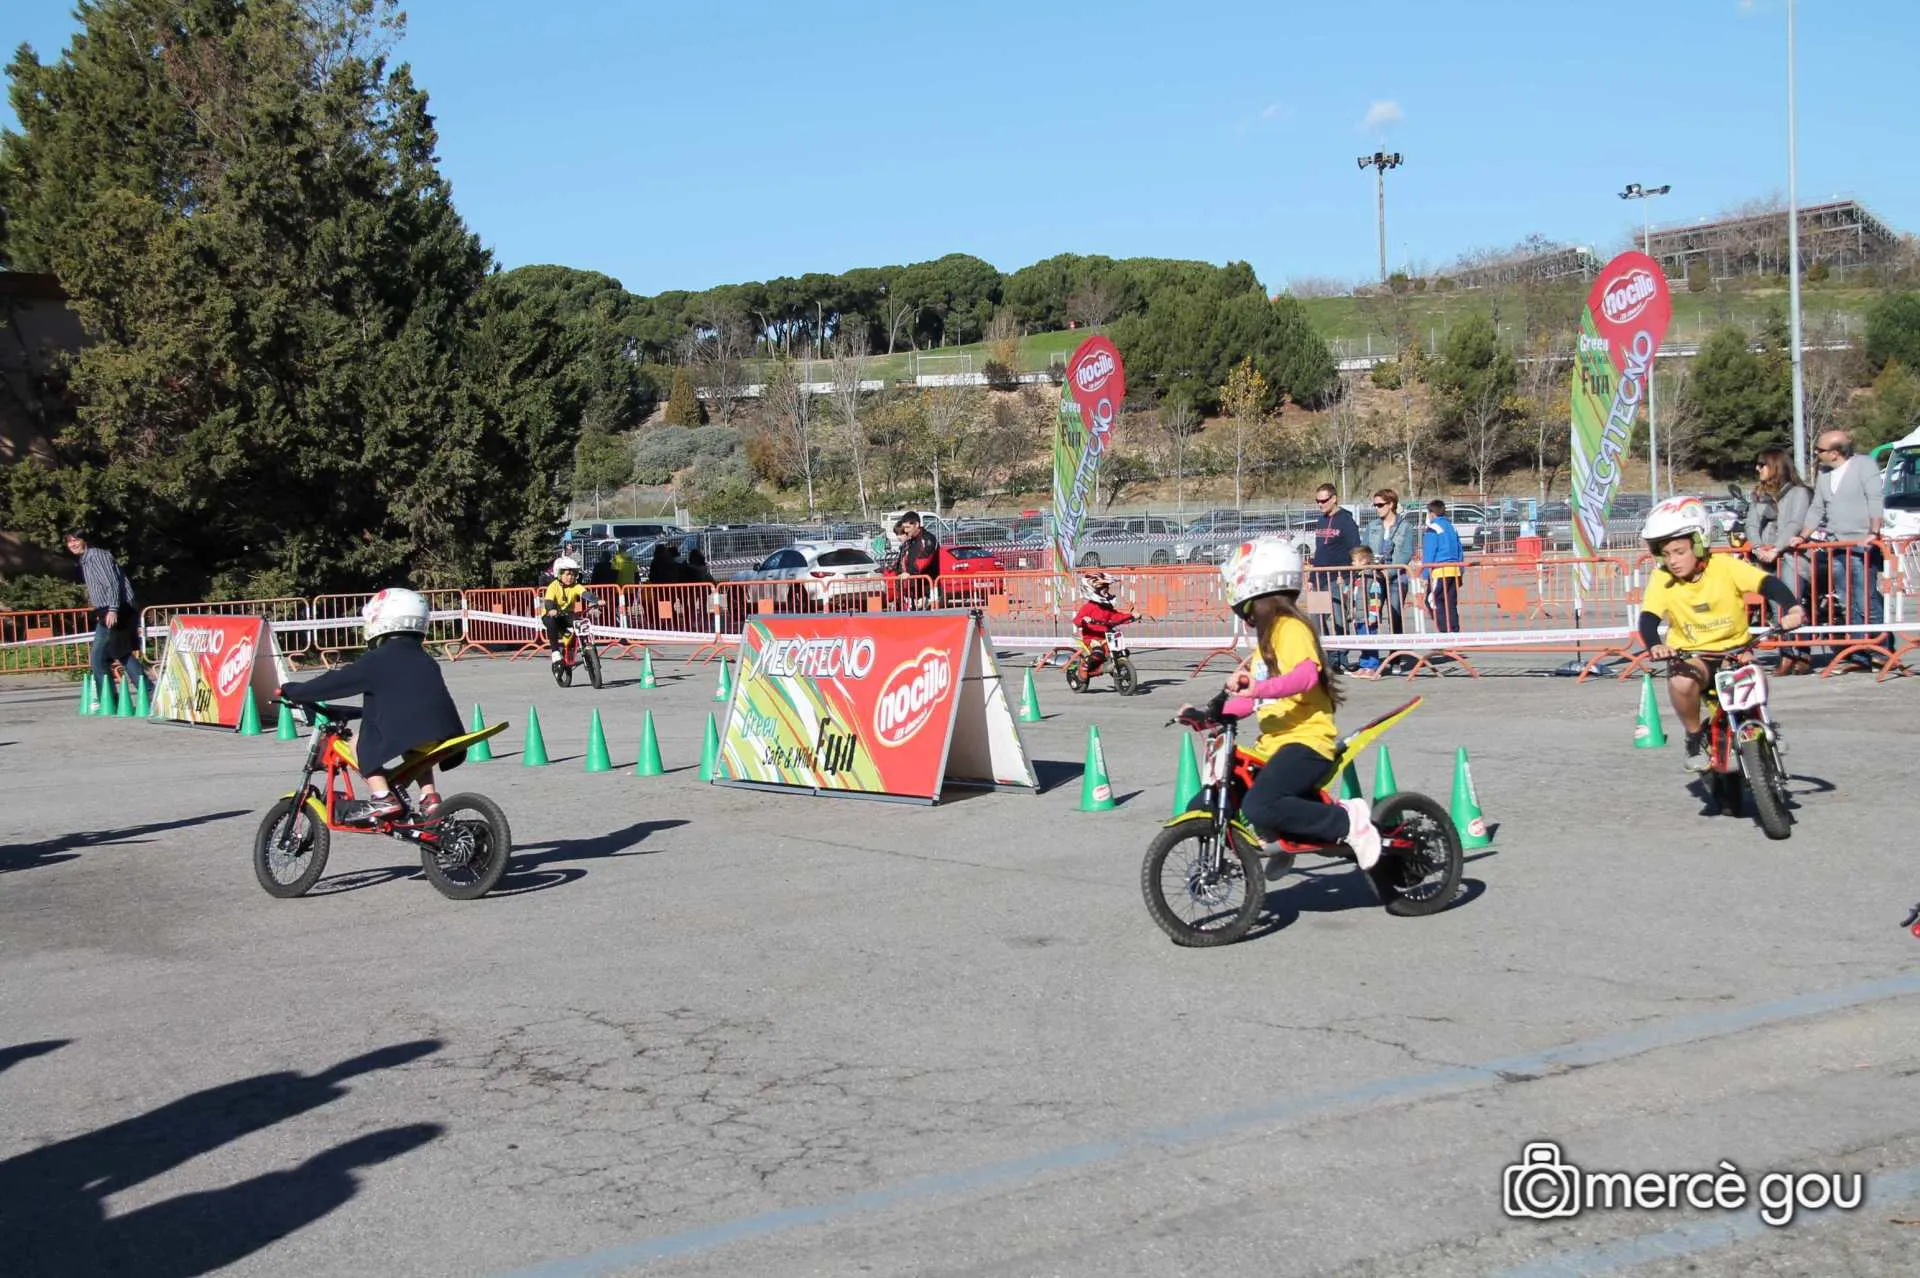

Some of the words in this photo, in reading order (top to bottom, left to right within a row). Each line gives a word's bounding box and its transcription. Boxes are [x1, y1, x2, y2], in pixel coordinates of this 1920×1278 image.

[1604, 273, 1655, 316] nocilla
[1580, 333, 1609, 352] Green
[1079, 354, 1113, 385] nocilla
[1578, 330, 1652, 548] MECATECNO
[749, 635, 876, 681] MECATECNO
[880, 658, 947, 733] nocilla
